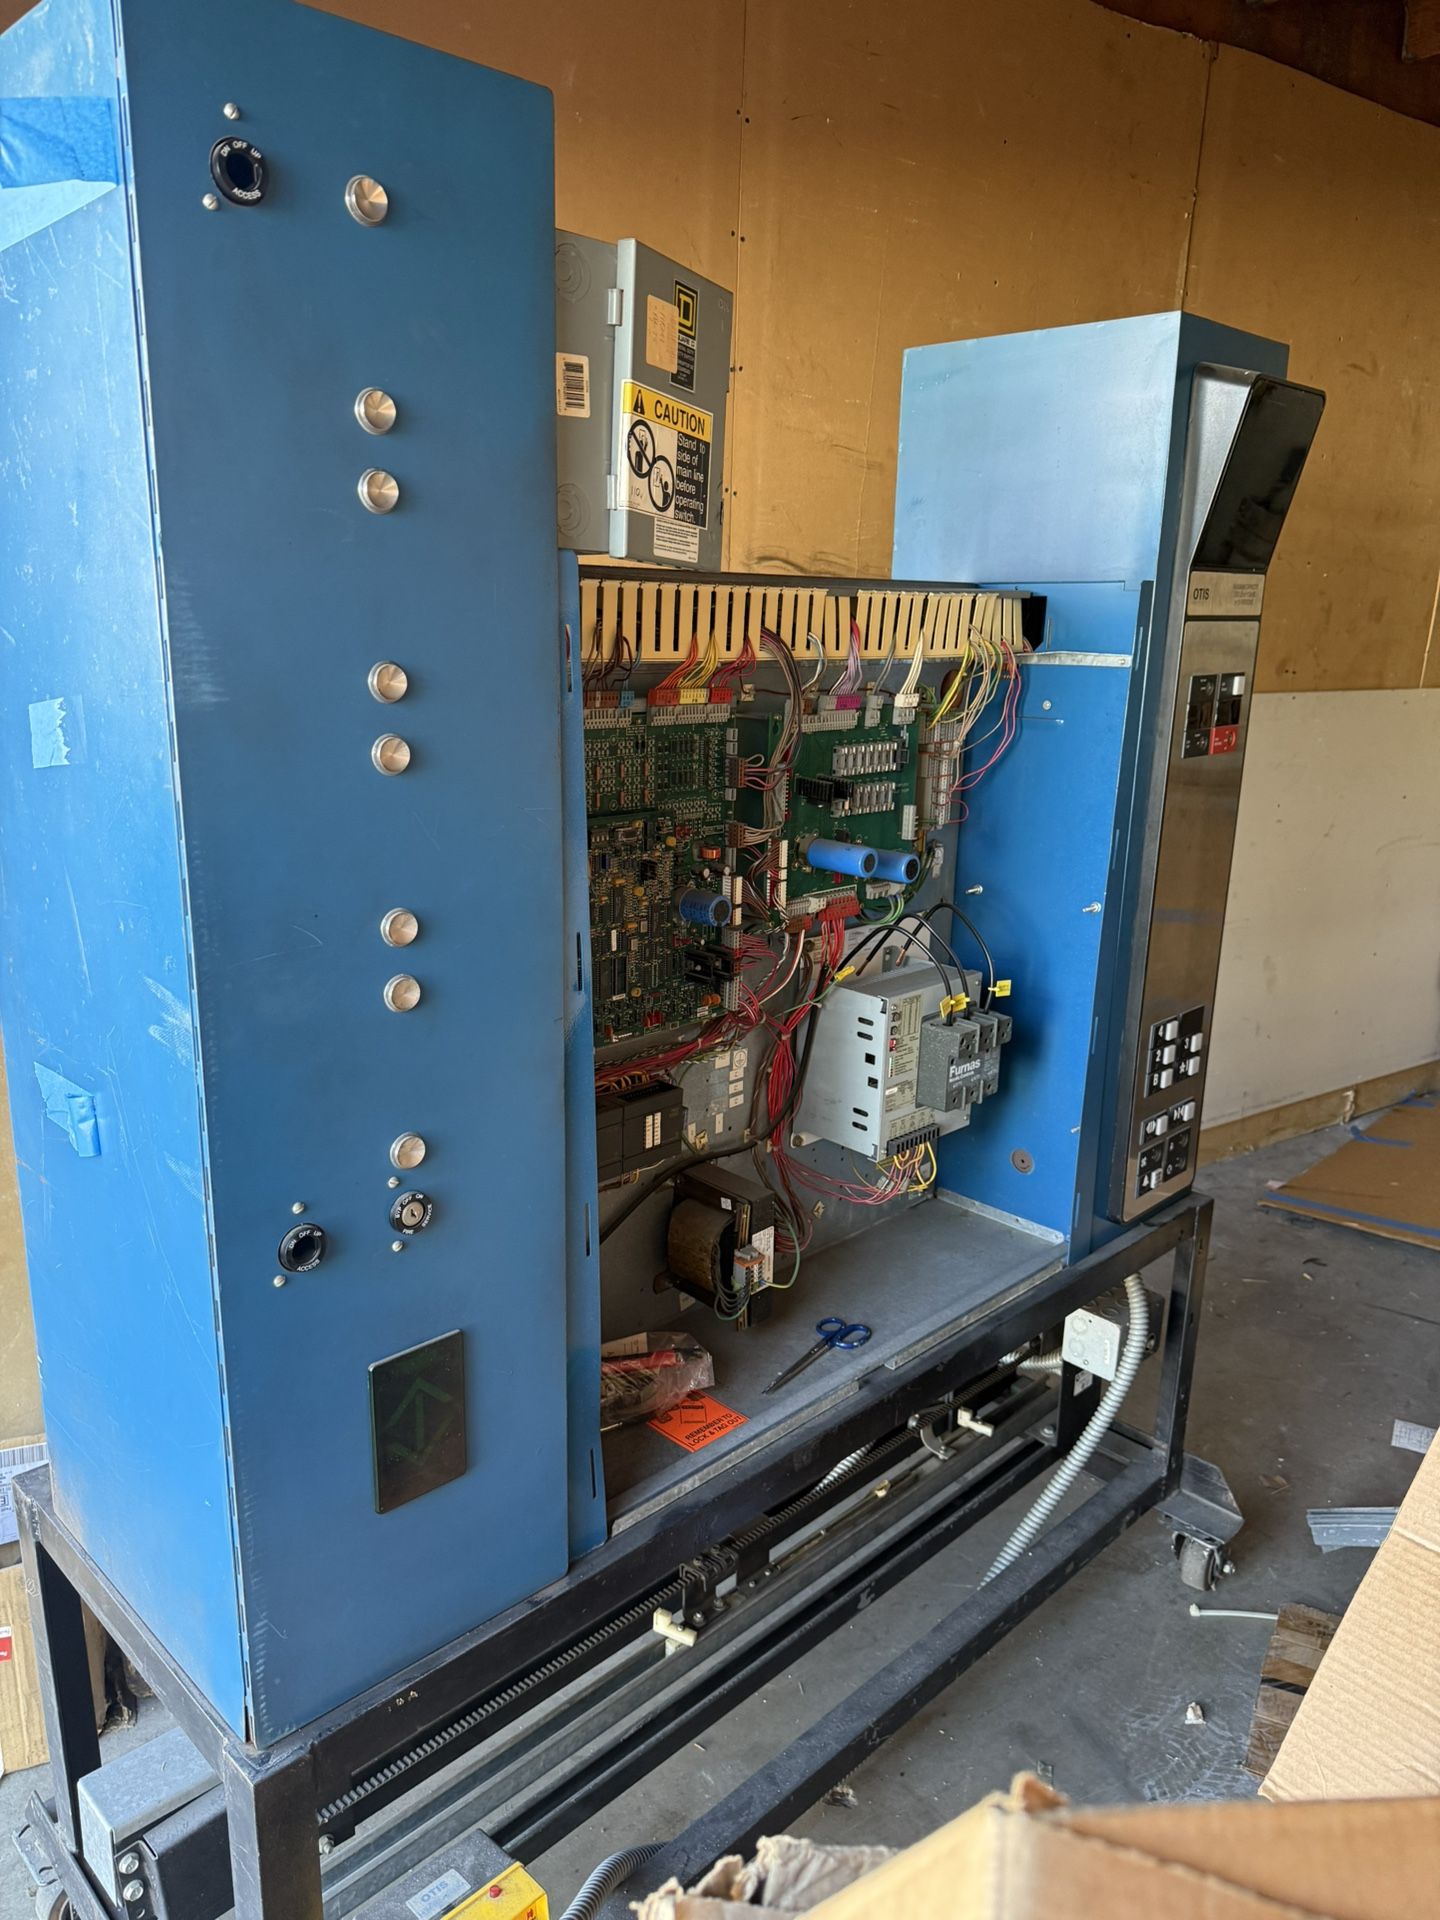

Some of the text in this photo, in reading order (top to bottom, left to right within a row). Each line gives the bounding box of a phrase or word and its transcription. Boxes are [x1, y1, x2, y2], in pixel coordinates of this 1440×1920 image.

[220, 140, 262, 159] DN OFF UP
[231, 186, 262, 200] ACCESS
[654, 399, 706, 437] CAUTION
[677, 432, 706, 455] Stand to
[676, 449, 699, 467] side of
[676, 464, 705, 484] main line
[676, 479, 696, 496] before
[675, 494, 705, 515] operating
[674, 509, 696, 525] switch.
[1193, 587, 1210, 601] OTIS
[1158, 1024, 1164, 1038] 4
[1184, 1037, 1190, 1050] 3
[1155, 1049, 1161, 1063] 2
[949, 1058, 981, 1078] Furnas
[402, 1195, 413, 1206] OFF
[298, 1229, 310, 1239] OFF
[296, 1258, 321, 1272] ACCESS
[684, 1412, 733, 1441] REMEMBER TO
[688, 1430, 709, 1447] LOCK
[715, 1421, 729, 1433] TAG
[727, 1415, 743, 1426] OUT
[420, 1880, 449, 1902] OTIS
